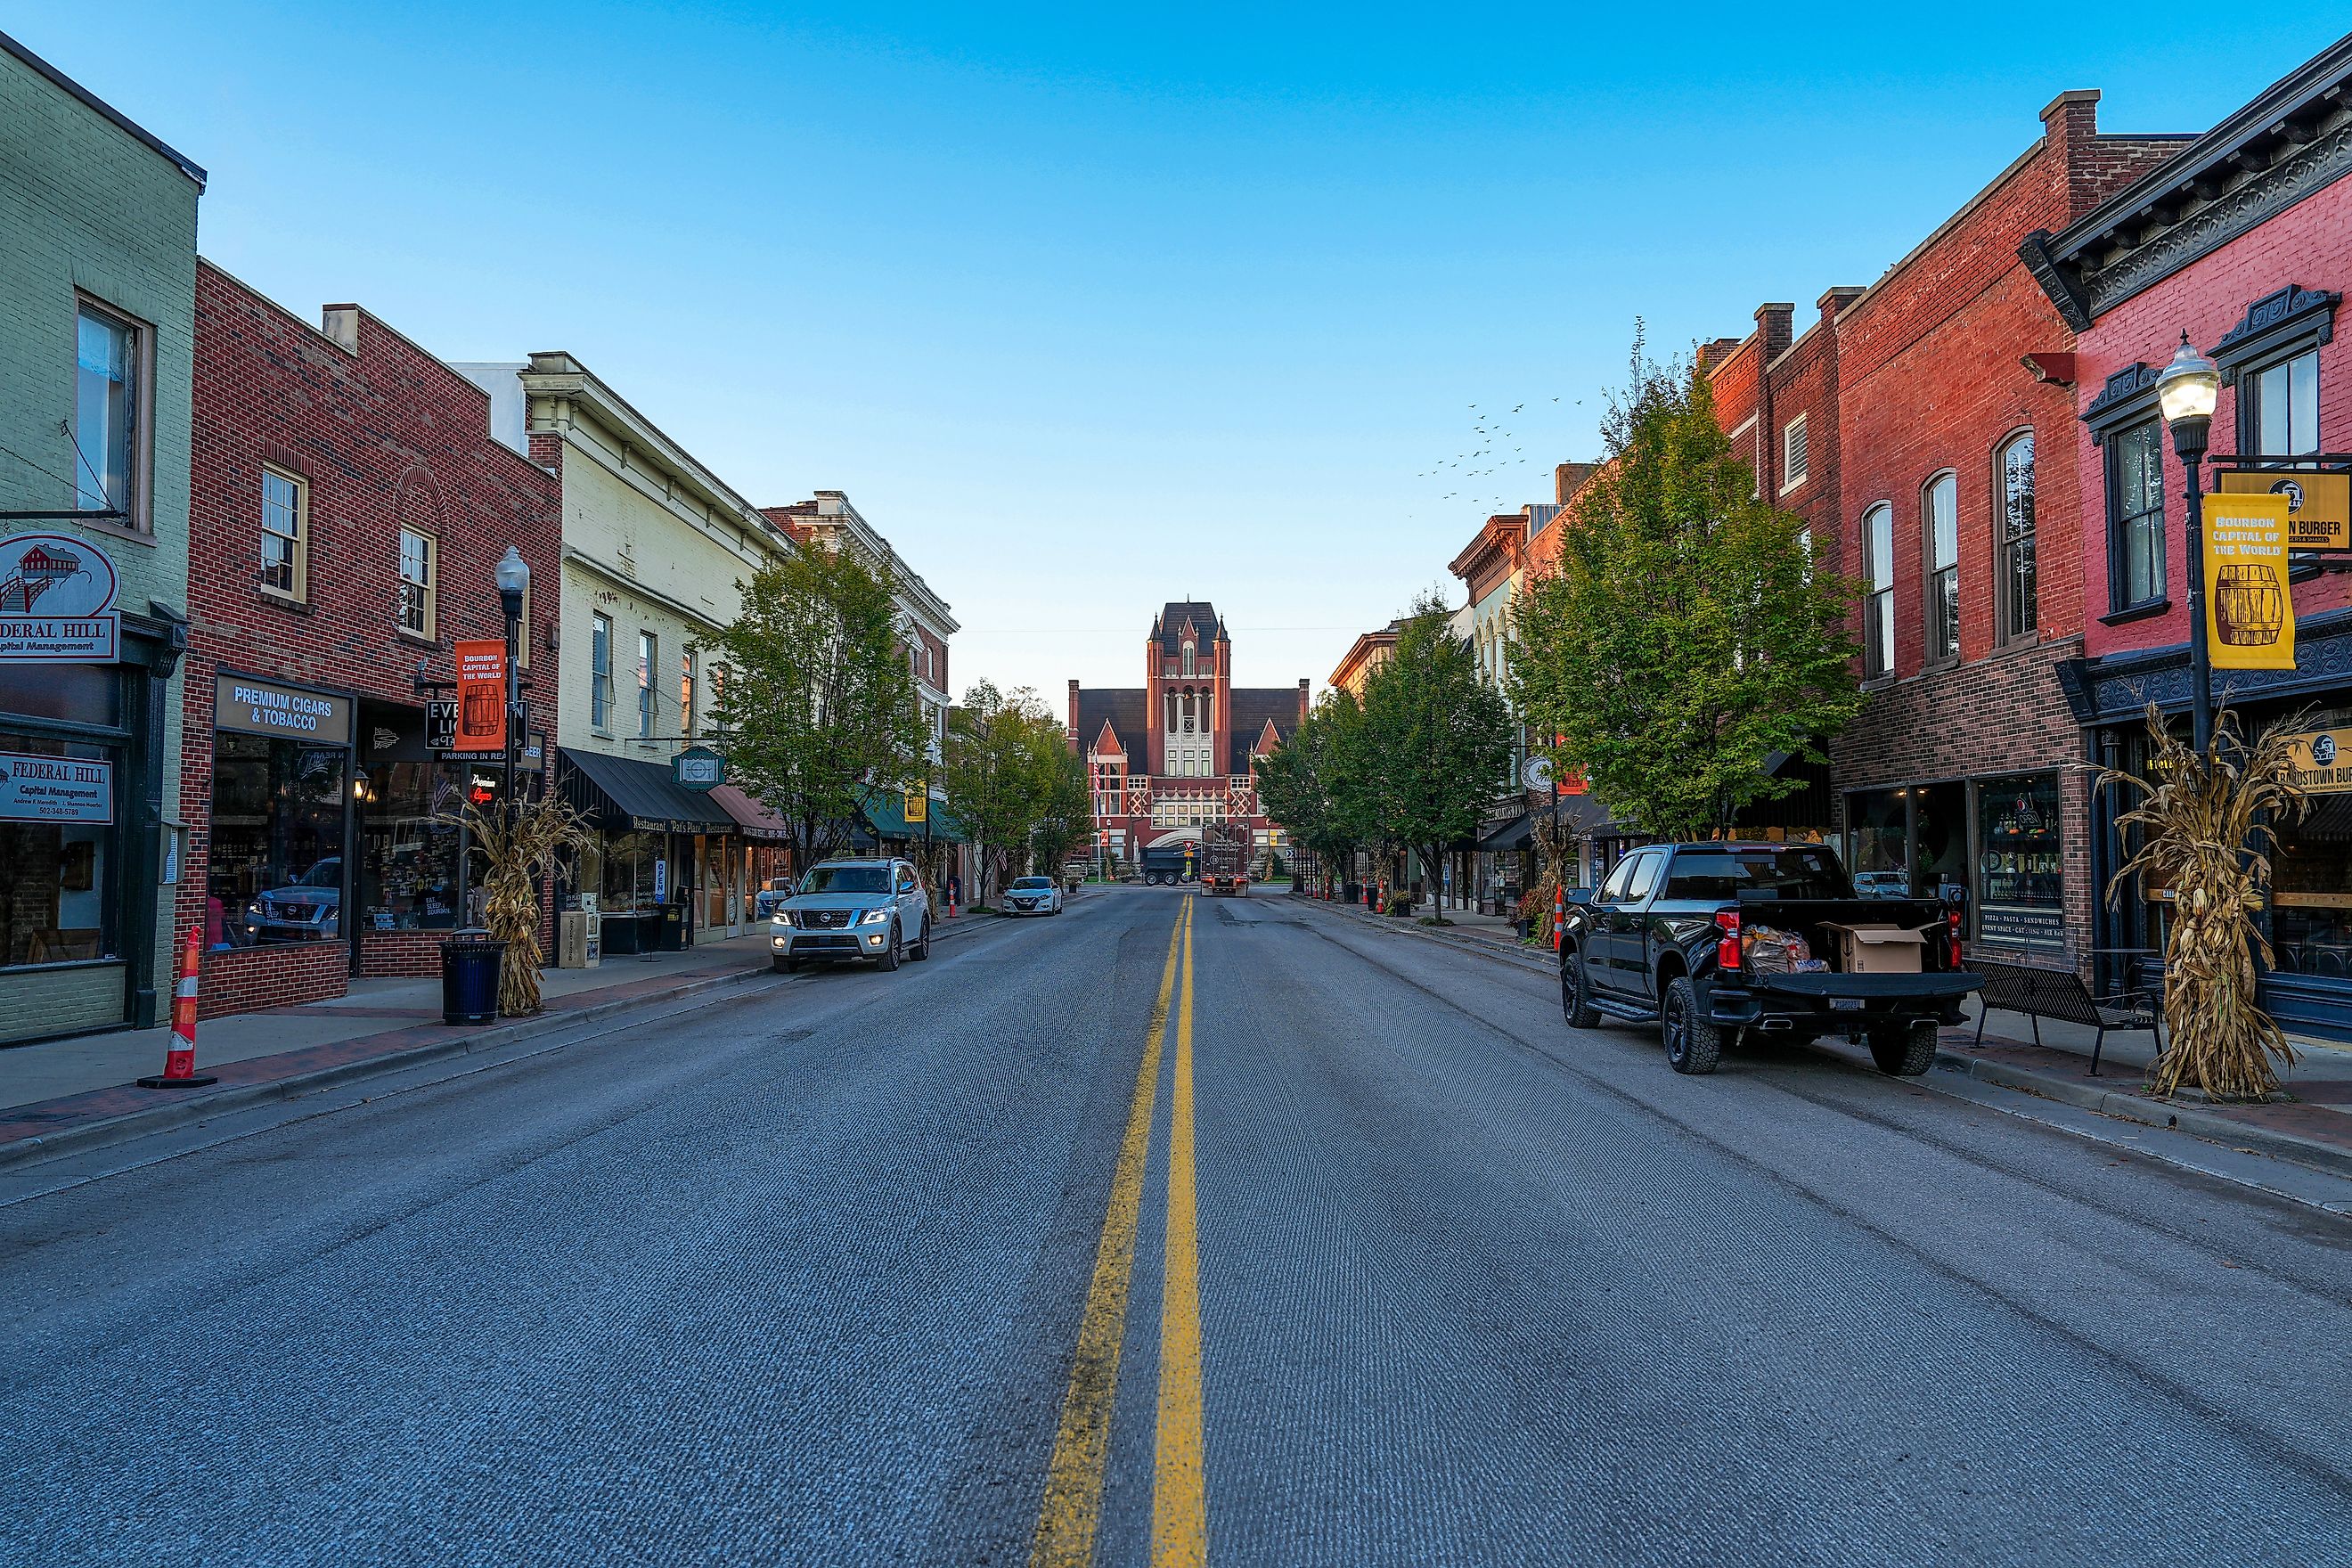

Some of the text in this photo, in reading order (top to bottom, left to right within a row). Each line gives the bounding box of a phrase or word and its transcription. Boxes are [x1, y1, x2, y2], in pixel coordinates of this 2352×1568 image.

[2216, 517, 2274, 528] BOURBON
[2299, 520, 2340, 535] BURGER
[2213, 530, 2280, 542] CAPITAL OF
[2213, 544, 2281, 556] THE WORLD
[0, 623, 106, 639] DERAL HILL
[0, 641, 94, 652] pital Management
[464, 655, 498, 663] BOURBON
[477, 672, 502, 680] WORLD
[234, 686, 332, 717] PREMIUM CIGARS
[251, 706, 317, 731] & TOBACCO
[441, 752, 478, 760] PARKING
[12, 761, 106, 785] FEDERAL HILL
[2281, 768, 2334, 785] BADSTOWN
[20, 784, 98, 799] Capital Management
[39, 807, 79, 816] 502-348-5789
[633, 816, 666, 831] Restaurant
[2019, 813, 2038, 824] OPEN
[2023, 917, 2059, 926] SANDWICHES
[1997, 925, 2012, 933] SPACE
